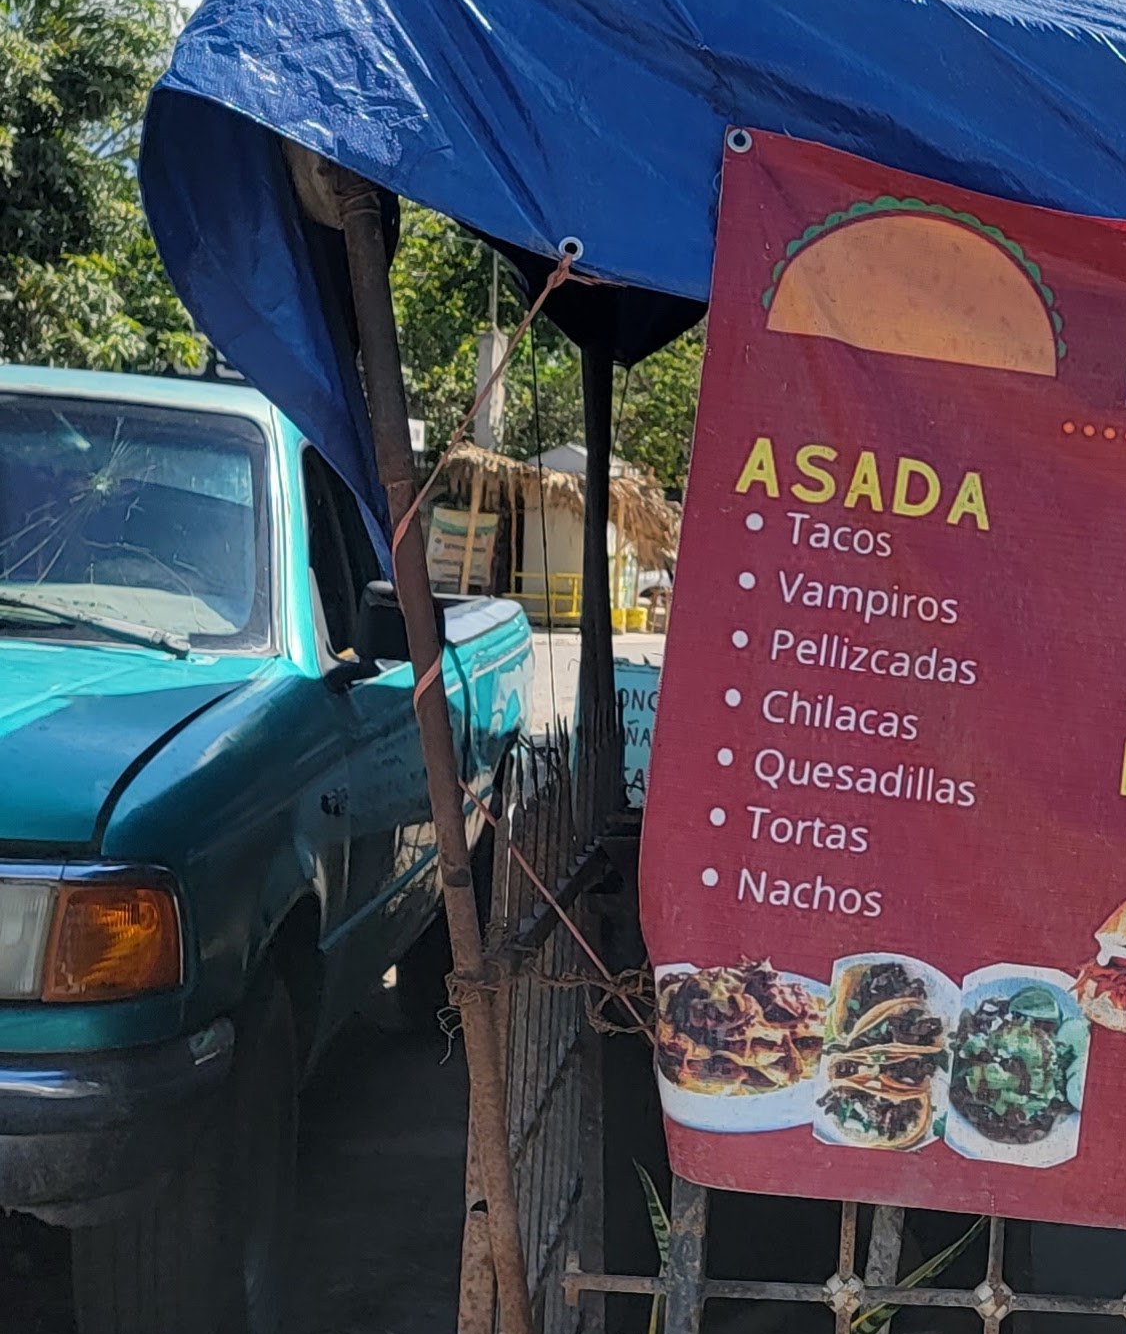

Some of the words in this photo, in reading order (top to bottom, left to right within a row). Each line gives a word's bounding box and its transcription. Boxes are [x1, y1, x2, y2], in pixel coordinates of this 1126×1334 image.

[735, 437, 990, 531] ASADA
[787, 512, 892, 557] Tacos
[778, 571, 959, 624] Vampiros
[770, 629, 978, 685] Pellizcadas
[761, 690, 919, 741] Chilacas
[753, 749, 977, 807] Quesadillas
[746, 806, 869, 853] Tortas
[736, 869, 883, 917] Nachos
